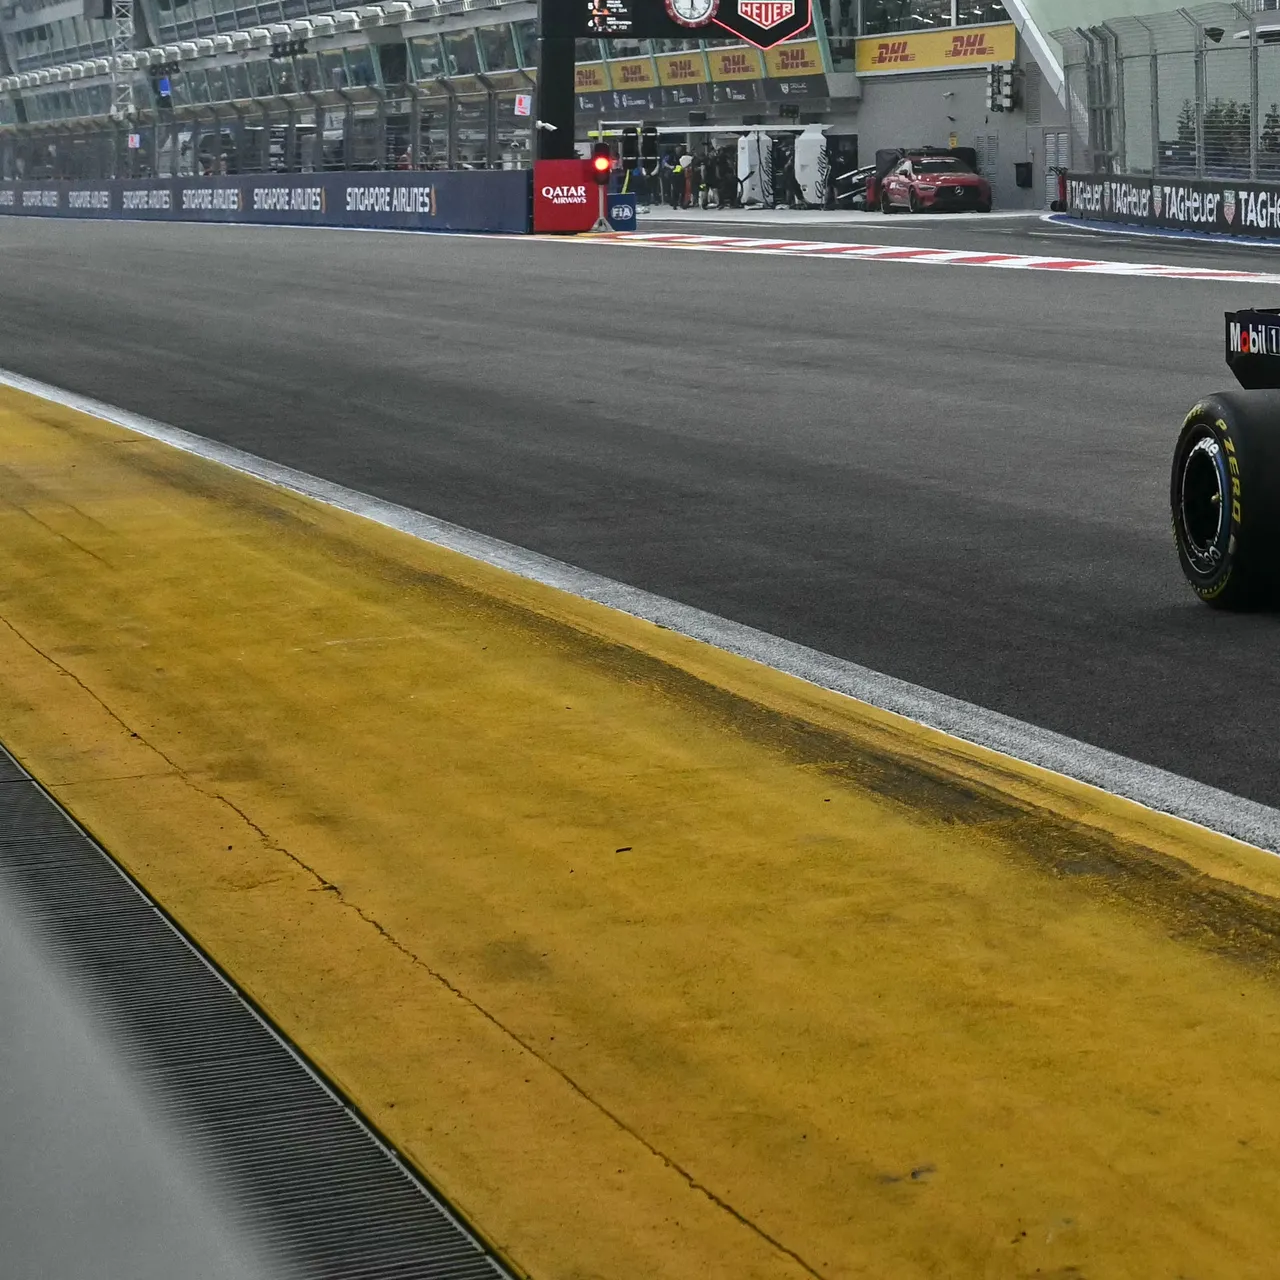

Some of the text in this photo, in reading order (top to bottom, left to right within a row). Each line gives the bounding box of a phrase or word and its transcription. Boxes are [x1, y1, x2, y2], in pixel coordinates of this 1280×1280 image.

[741, 2, 793, 28] HEUER
[877, 41, 910, 64] DHL
[951, 33, 988, 58] DHL
[669, 59, 698, 79] DHL
[721, 54, 752, 74] DHL
[779, 48, 811, 70] DHL
[182, 188, 239, 210] SINGAPORE AIRLINES
[254, 187, 321, 211] SINGAPORE AIRLINES
[346, 186, 430, 212] SINGAPORE AIRLINES
[541, 185, 586, 199] QATAR
[611, 207, 632, 218] FIA
[1229, 321, 1267, 355] Mobil
[1216, 418, 1242, 524] P ZERO
